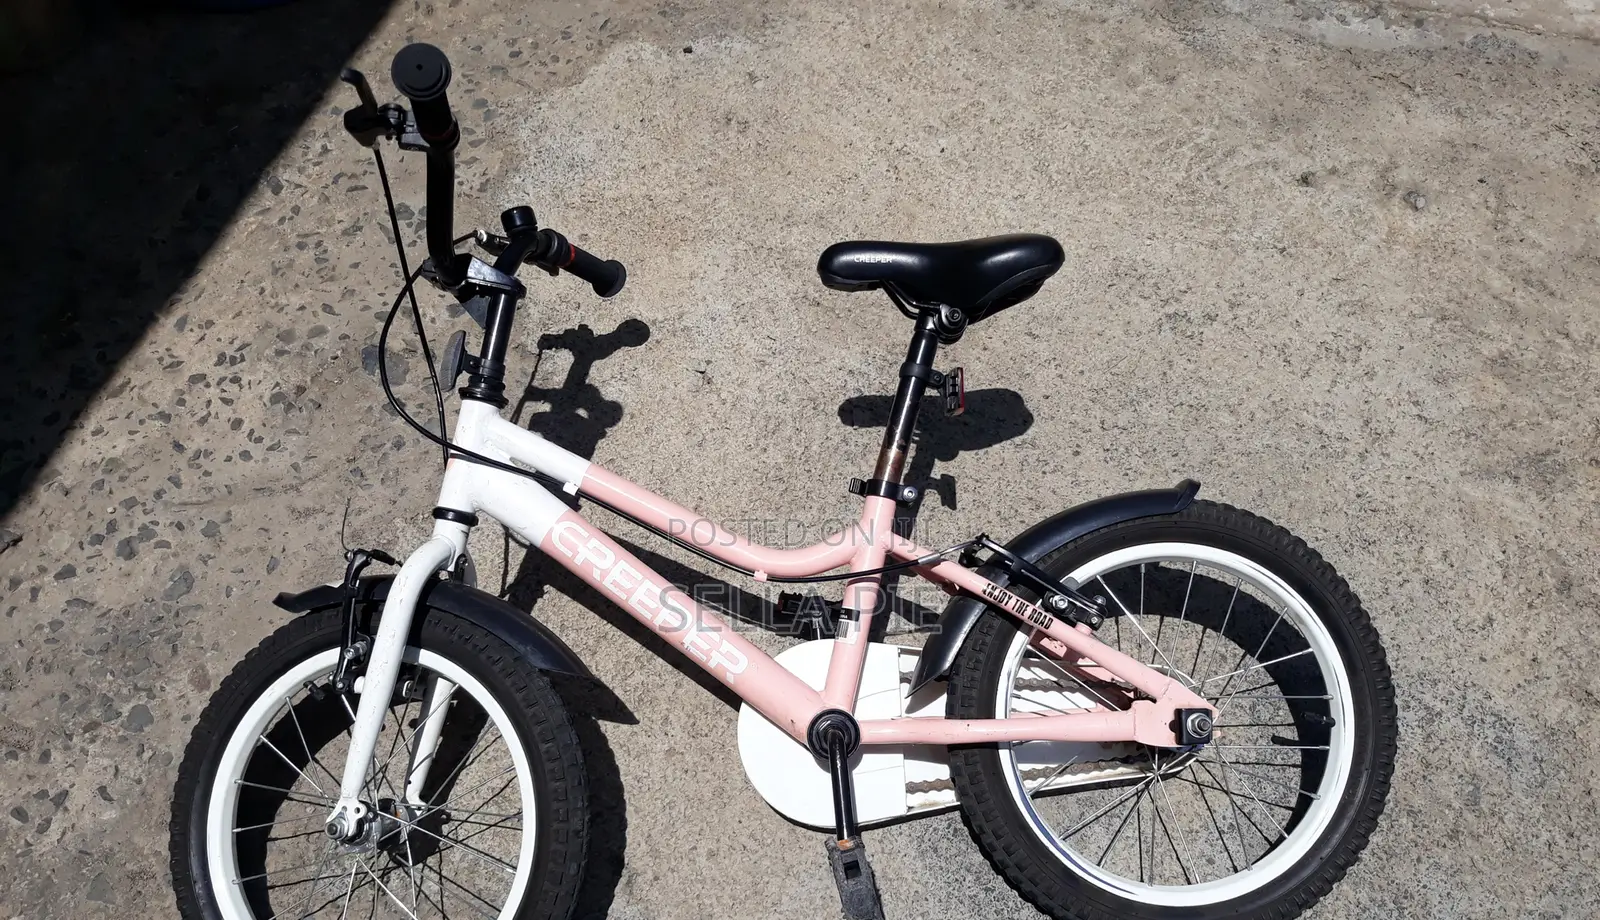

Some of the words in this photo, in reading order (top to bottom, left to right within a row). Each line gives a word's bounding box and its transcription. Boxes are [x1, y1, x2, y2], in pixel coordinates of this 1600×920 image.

[854, 254, 892, 264] CREEPER
[551, 520, 749, 685] CREEPER
[982, 583, 1013, 606] ENJOY
[1012, 599, 1030, 616] THE
[1027, 607, 1054, 630] ROAD
